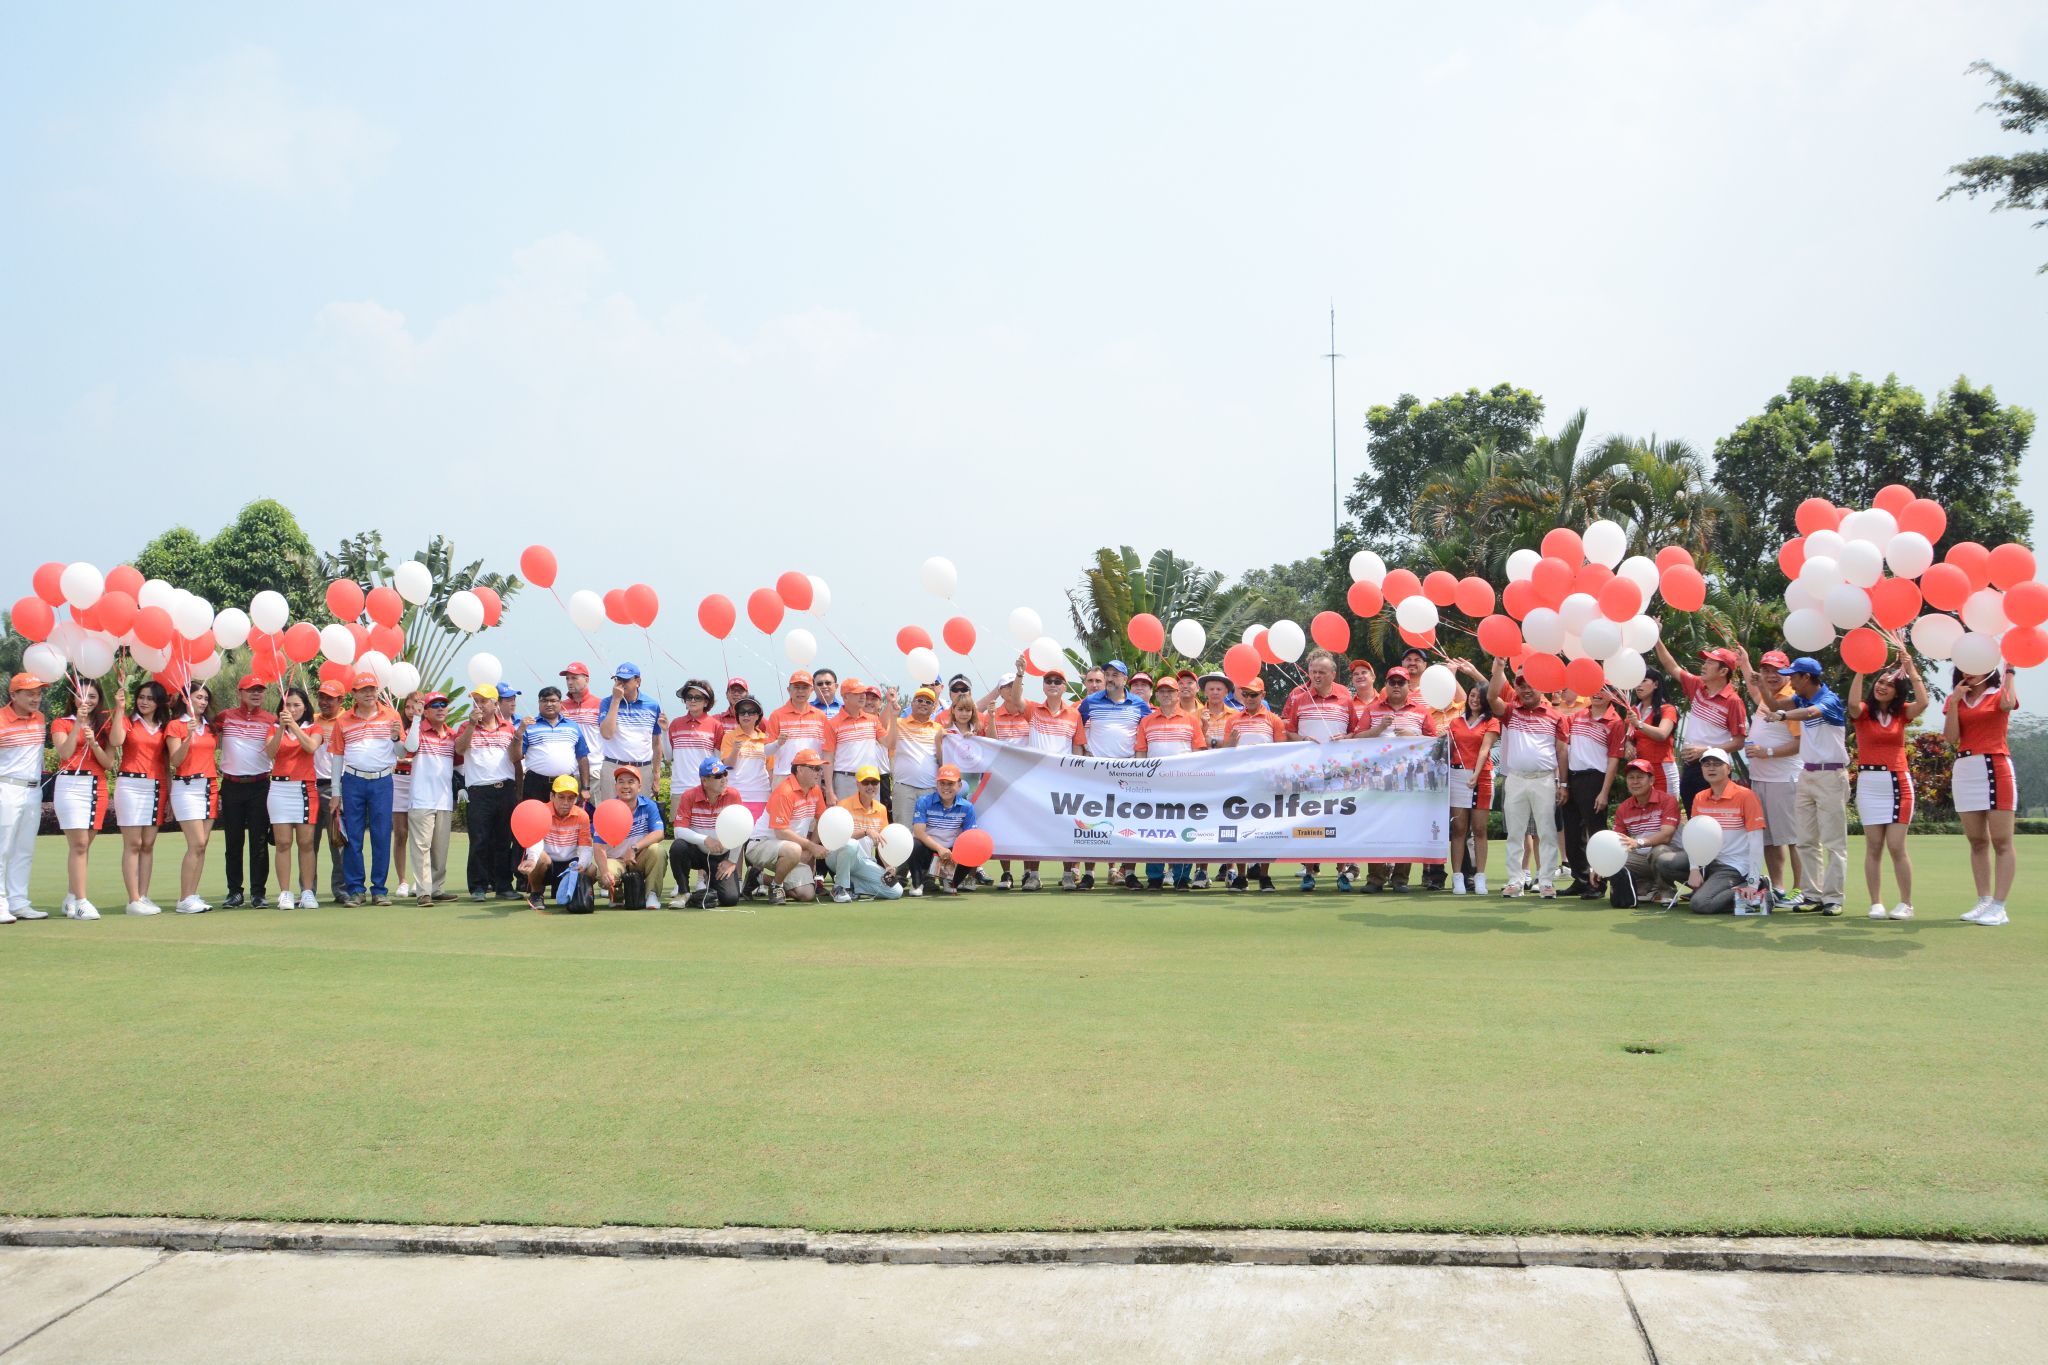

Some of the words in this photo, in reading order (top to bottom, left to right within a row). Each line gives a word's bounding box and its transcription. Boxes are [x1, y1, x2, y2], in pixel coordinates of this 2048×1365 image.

[1050, 792, 1209, 821] Welcome
[1222, 793, 1357, 821] Golfers
[1074, 828, 1108, 839] Dulux
[1137, 828, 1177, 839] TATA
[1325, 829, 1336, 837] CAT
